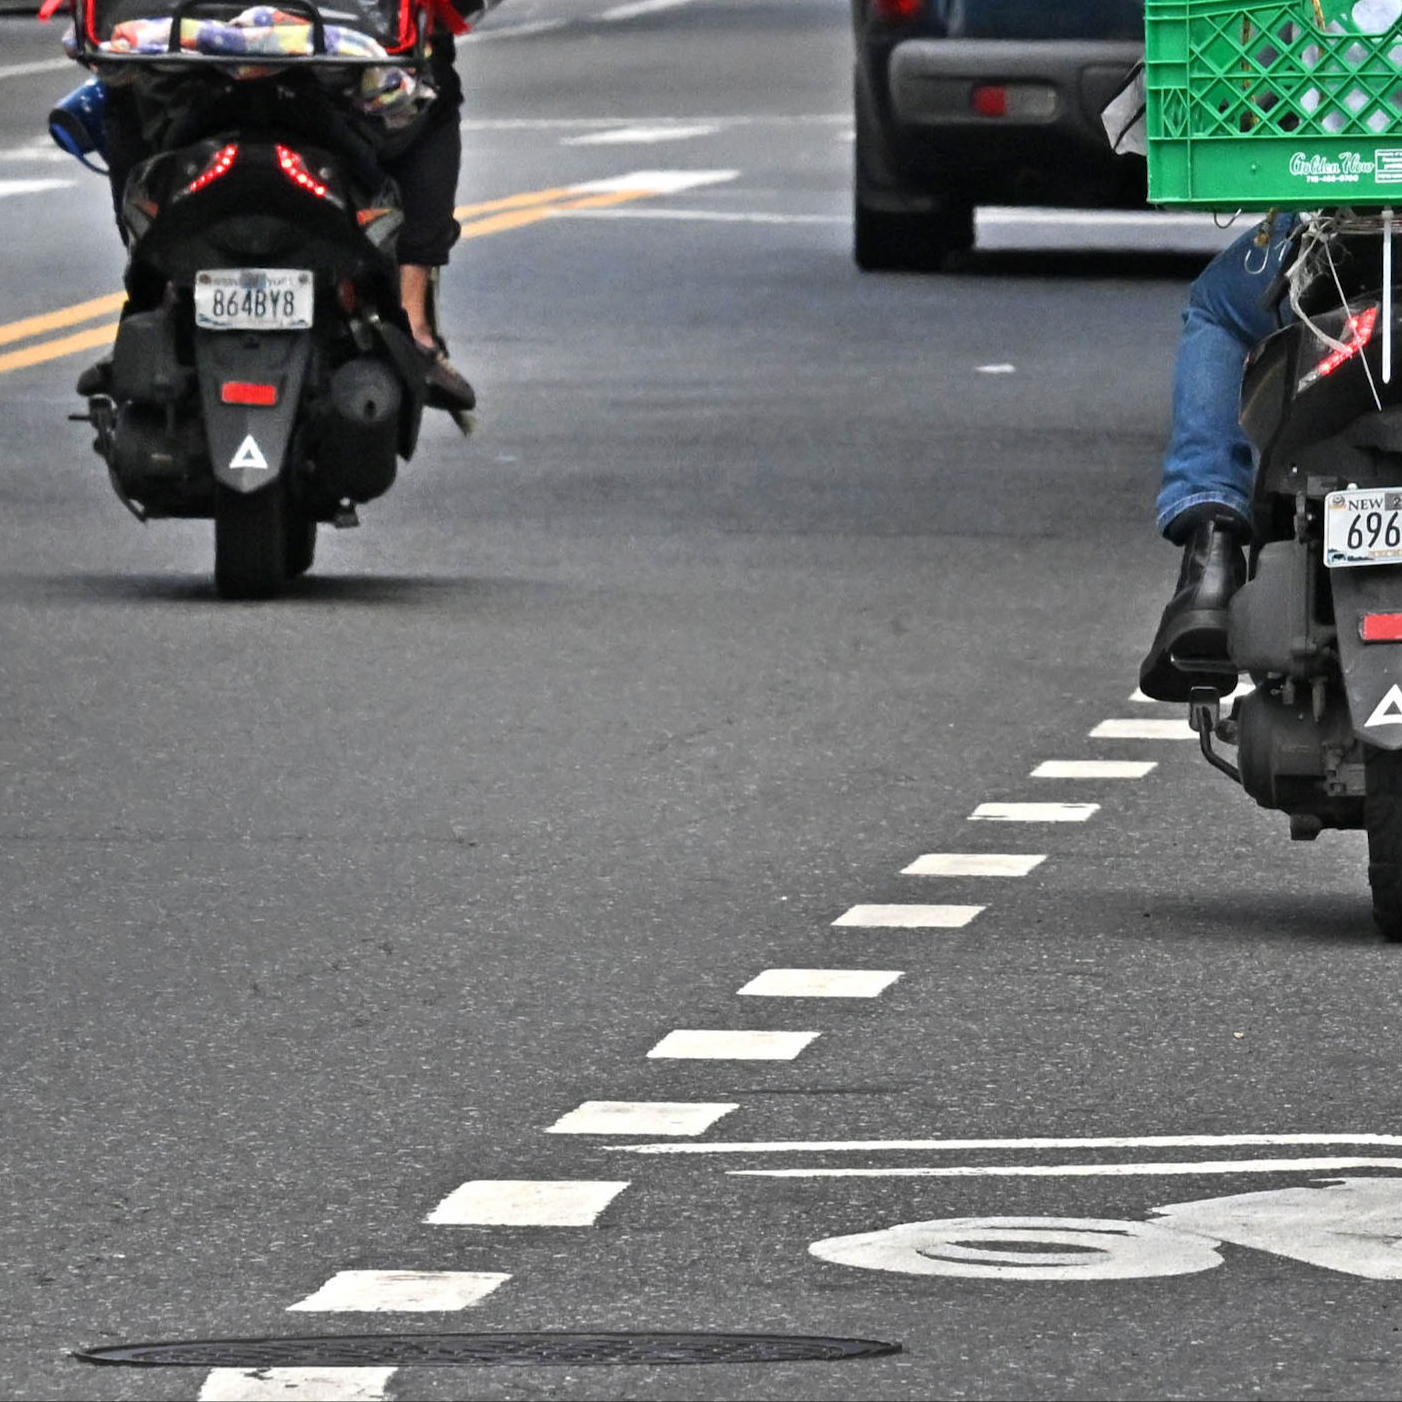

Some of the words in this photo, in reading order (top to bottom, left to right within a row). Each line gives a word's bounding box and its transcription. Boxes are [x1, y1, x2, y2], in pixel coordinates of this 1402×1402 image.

[1289, 152, 1340, 175] Golden
[213, 289, 295, 317] 864BY8
[1348, 498, 1383, 511] NEW
